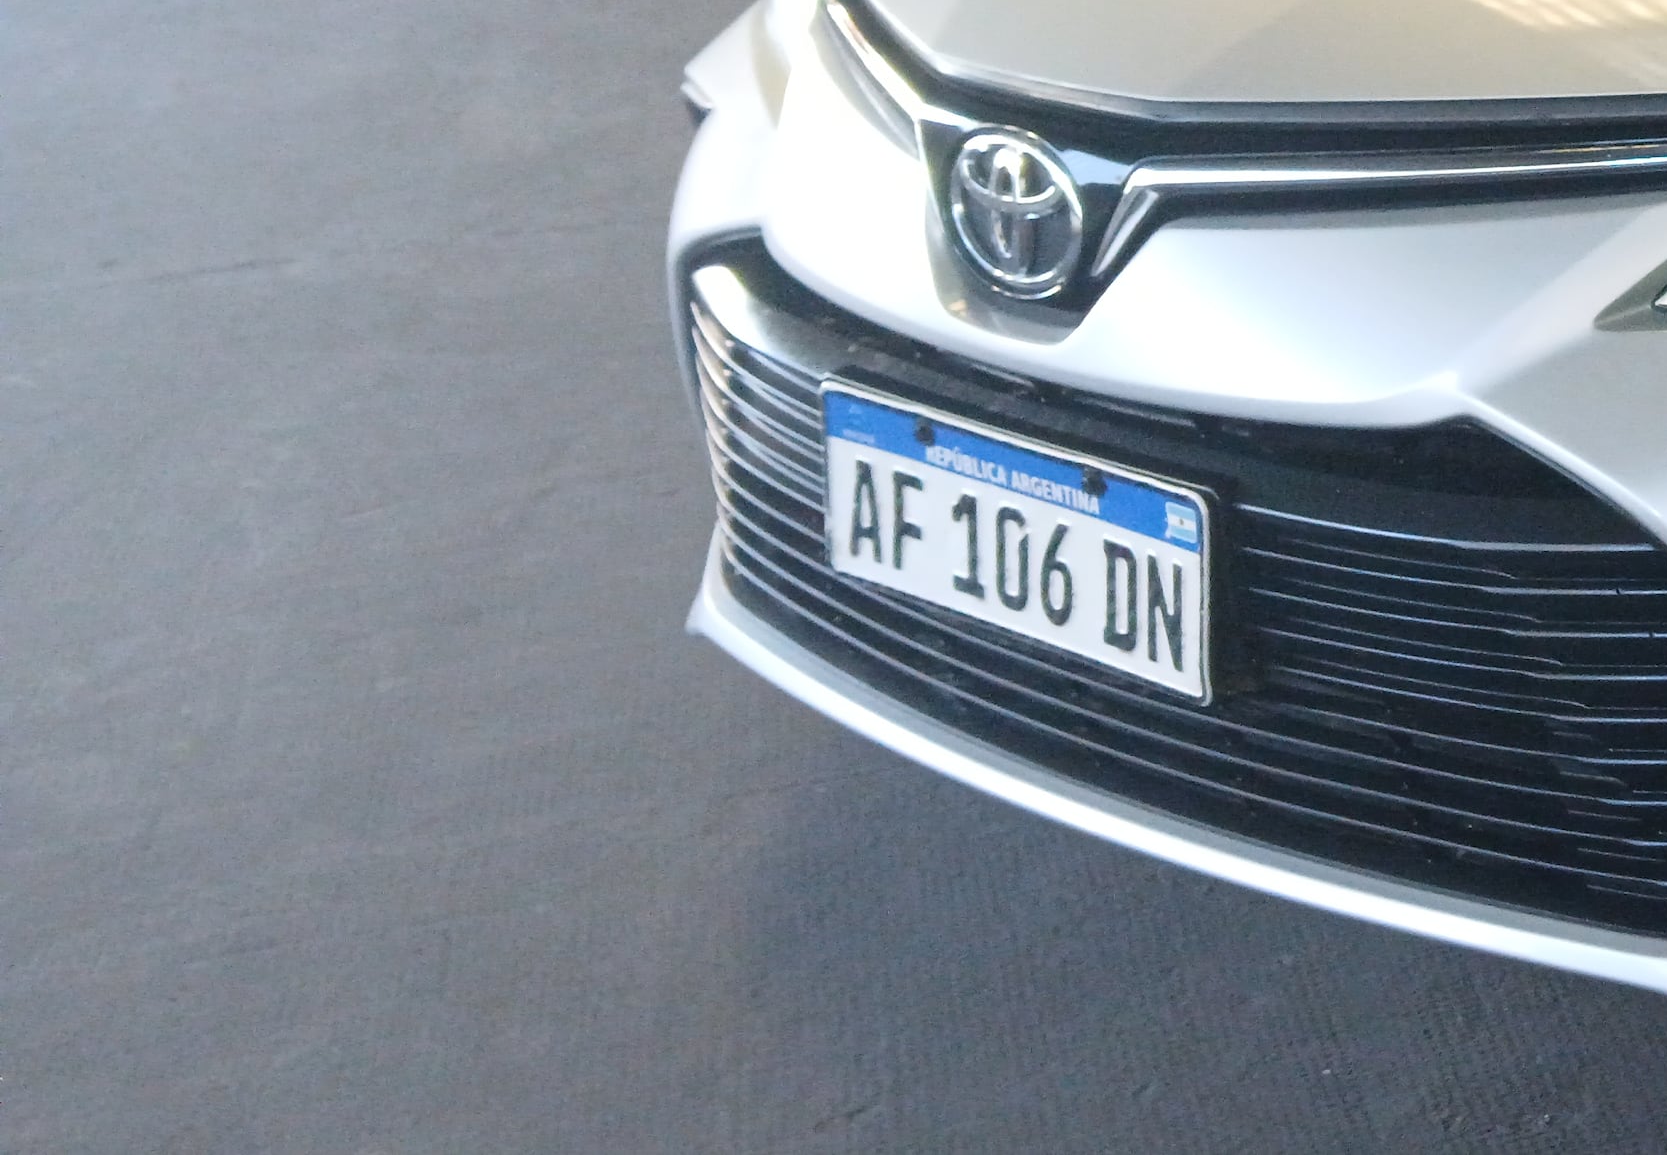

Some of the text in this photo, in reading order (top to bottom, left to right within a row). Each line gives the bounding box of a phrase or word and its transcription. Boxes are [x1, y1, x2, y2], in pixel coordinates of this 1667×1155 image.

[925, 445, 1100, 515] REPÚBLICA ARGENTINA
[849, 459, 1184, 673] AF 106 DN
